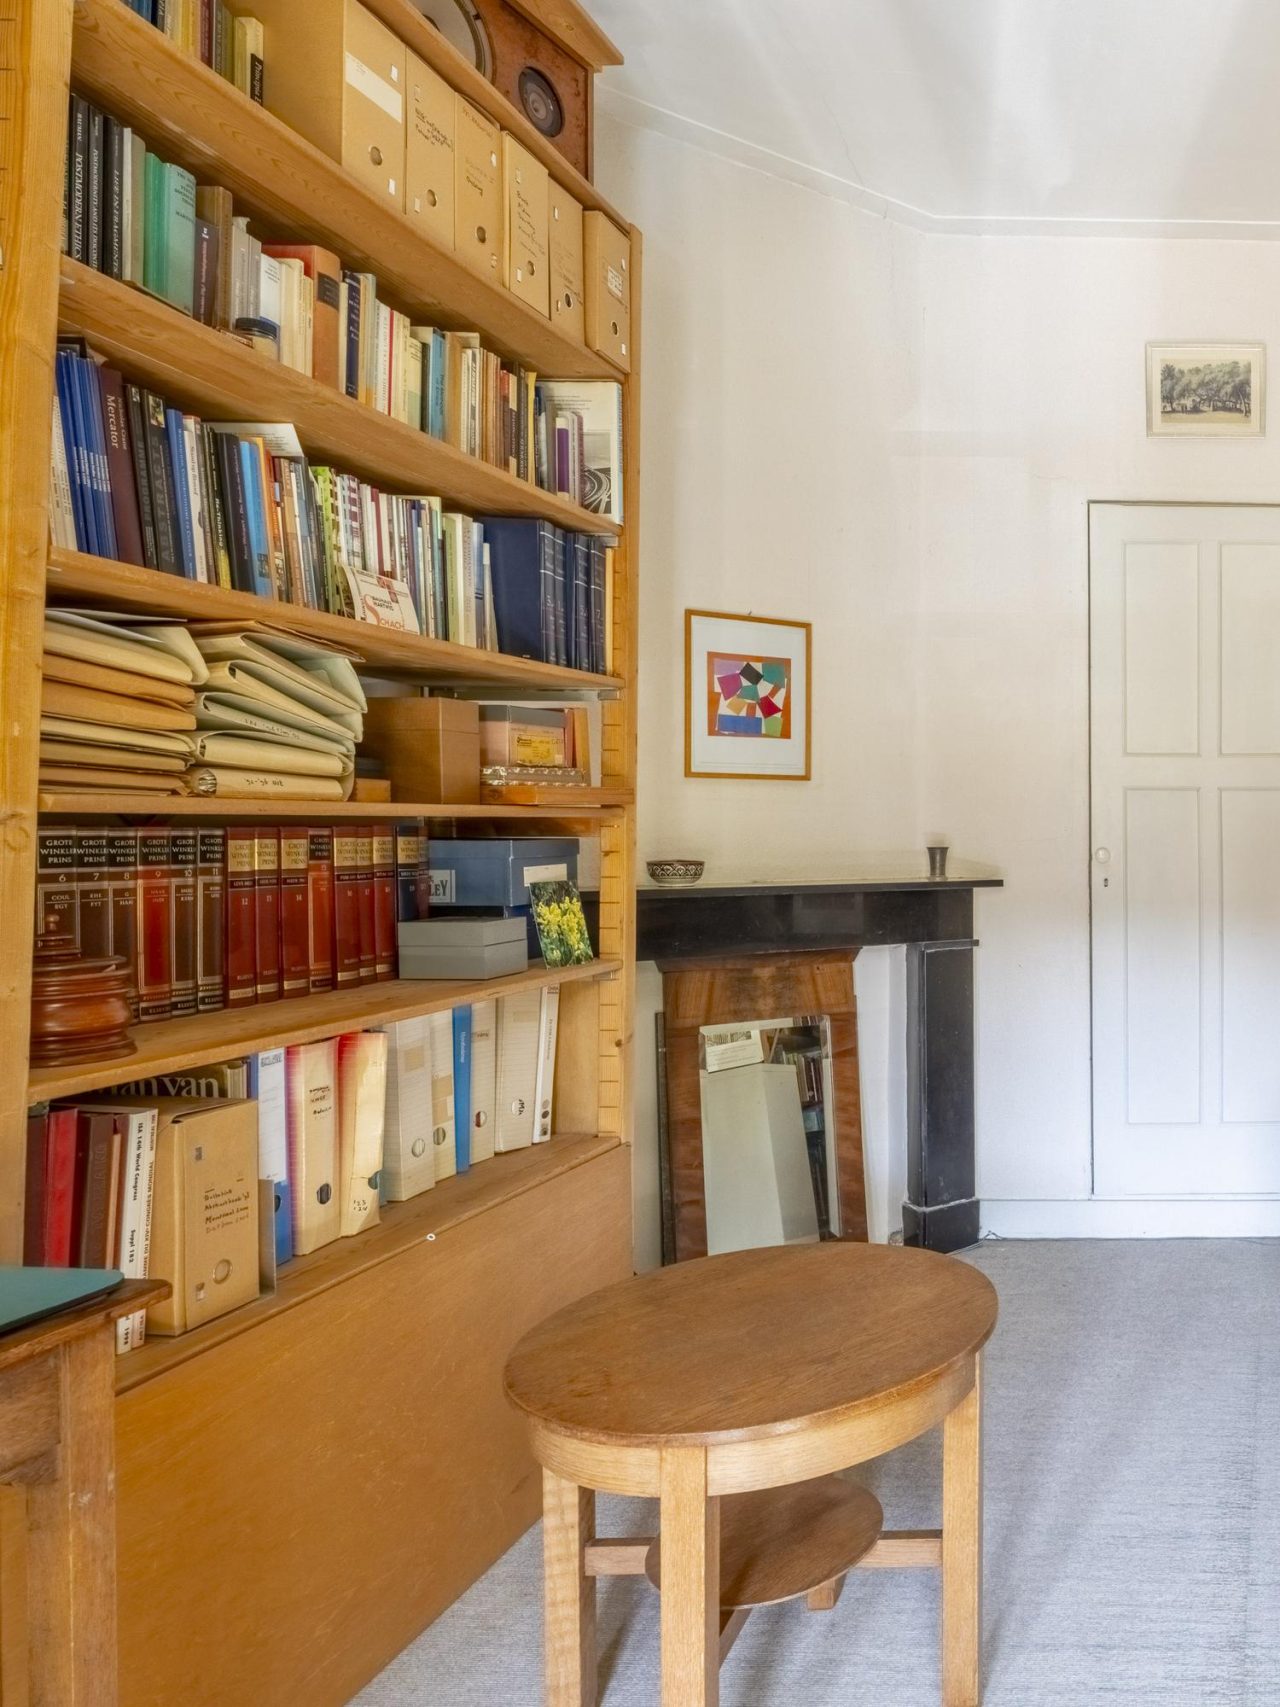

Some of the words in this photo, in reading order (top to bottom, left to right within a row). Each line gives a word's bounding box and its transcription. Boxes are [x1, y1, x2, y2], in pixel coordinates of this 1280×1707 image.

[75, 152, 84, 220] POSTMODERN
[75, 221, 83, 261] ETHICS
[106, 394, 120, 449] Mercator
[151, 437, 171, 562] ABSTRACTS
[134, 1152, 142, 1171] World
[132, 1172, 140, 1201] Congress
